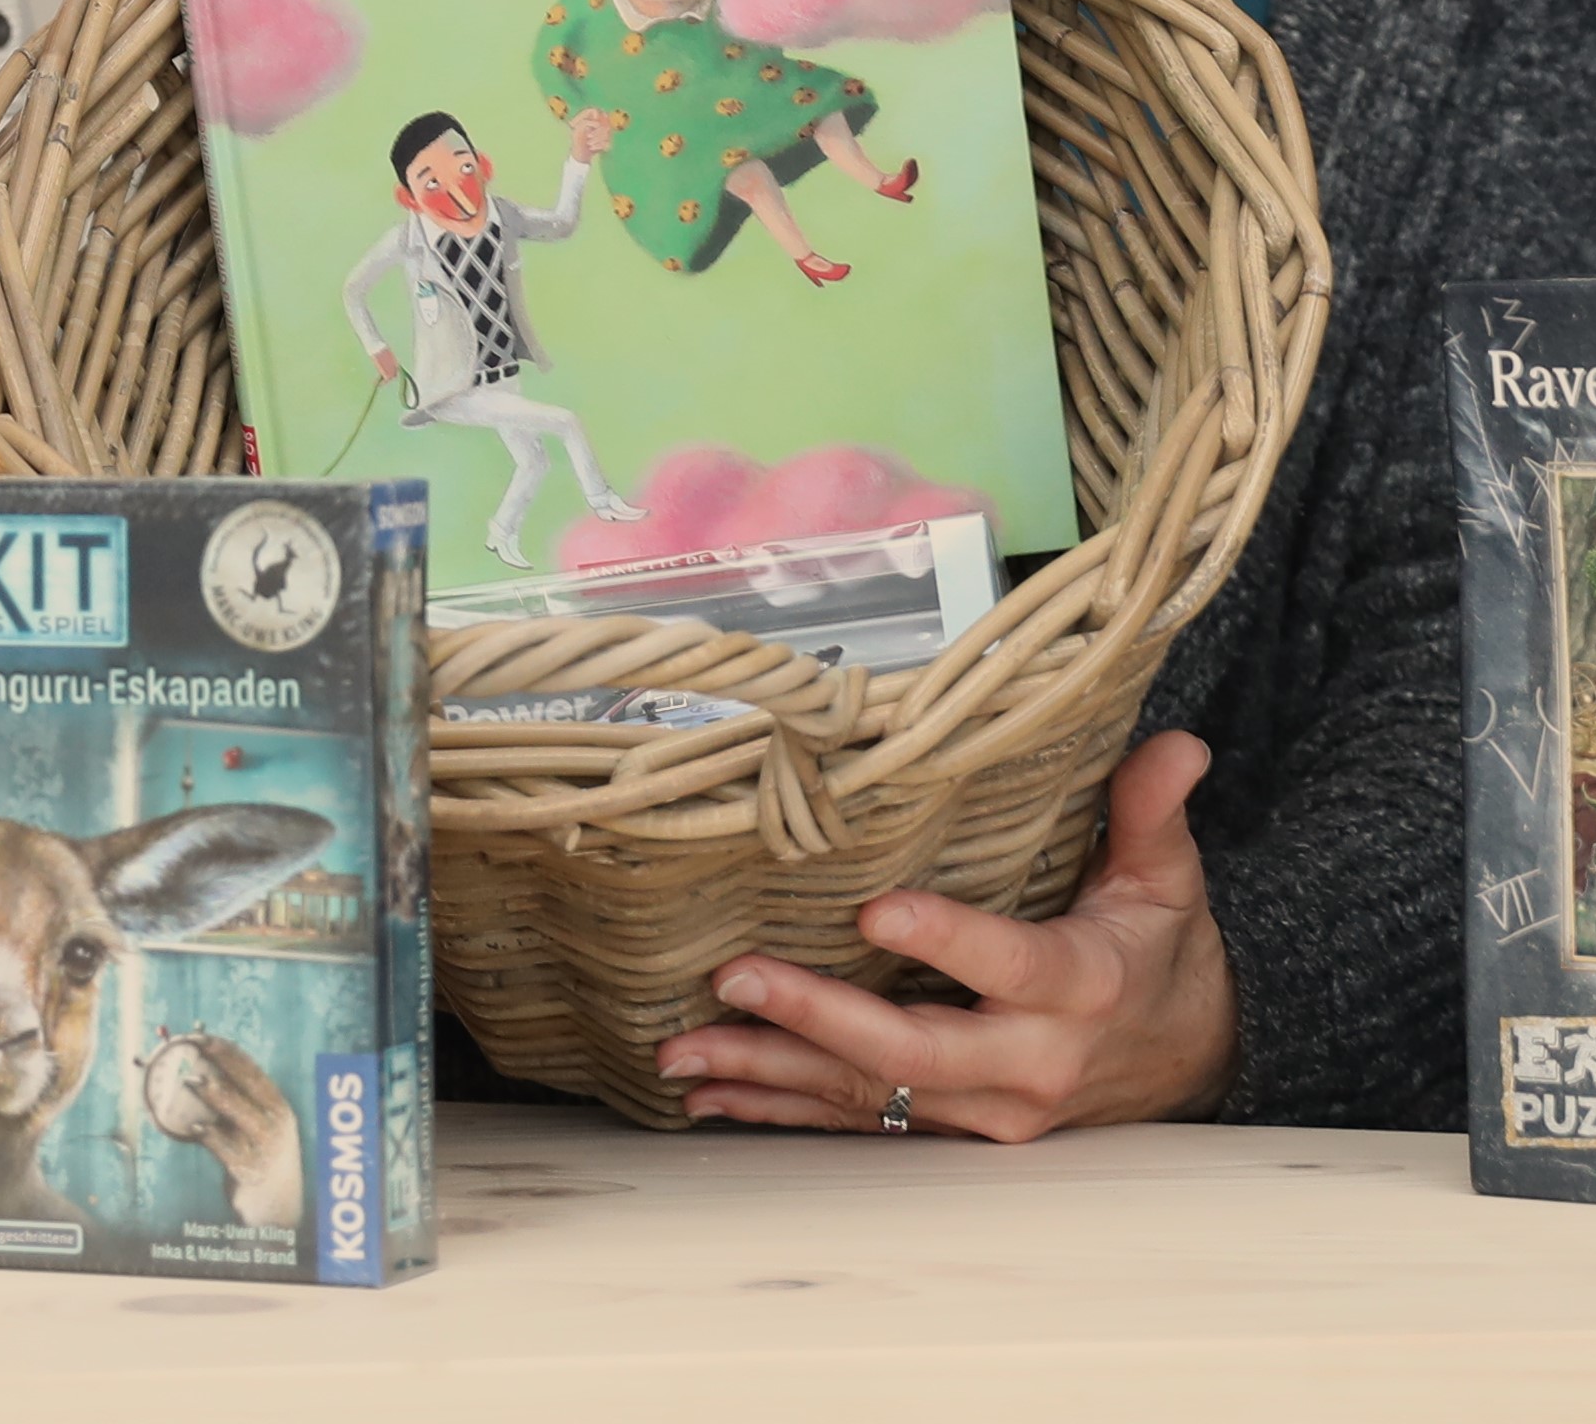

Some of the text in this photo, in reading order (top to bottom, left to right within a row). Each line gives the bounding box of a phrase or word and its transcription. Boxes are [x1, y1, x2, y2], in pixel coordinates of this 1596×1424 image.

[39, 617, 113, 636] SPIEL
[443, 695, 600, 722] Power
[329, 1072, 367, 1262] KOSMOS
[183, 1221, 296, 1247] Marc-Uwe Kling
[151, 1243, 297, 1266] Inka & Markus Brand
